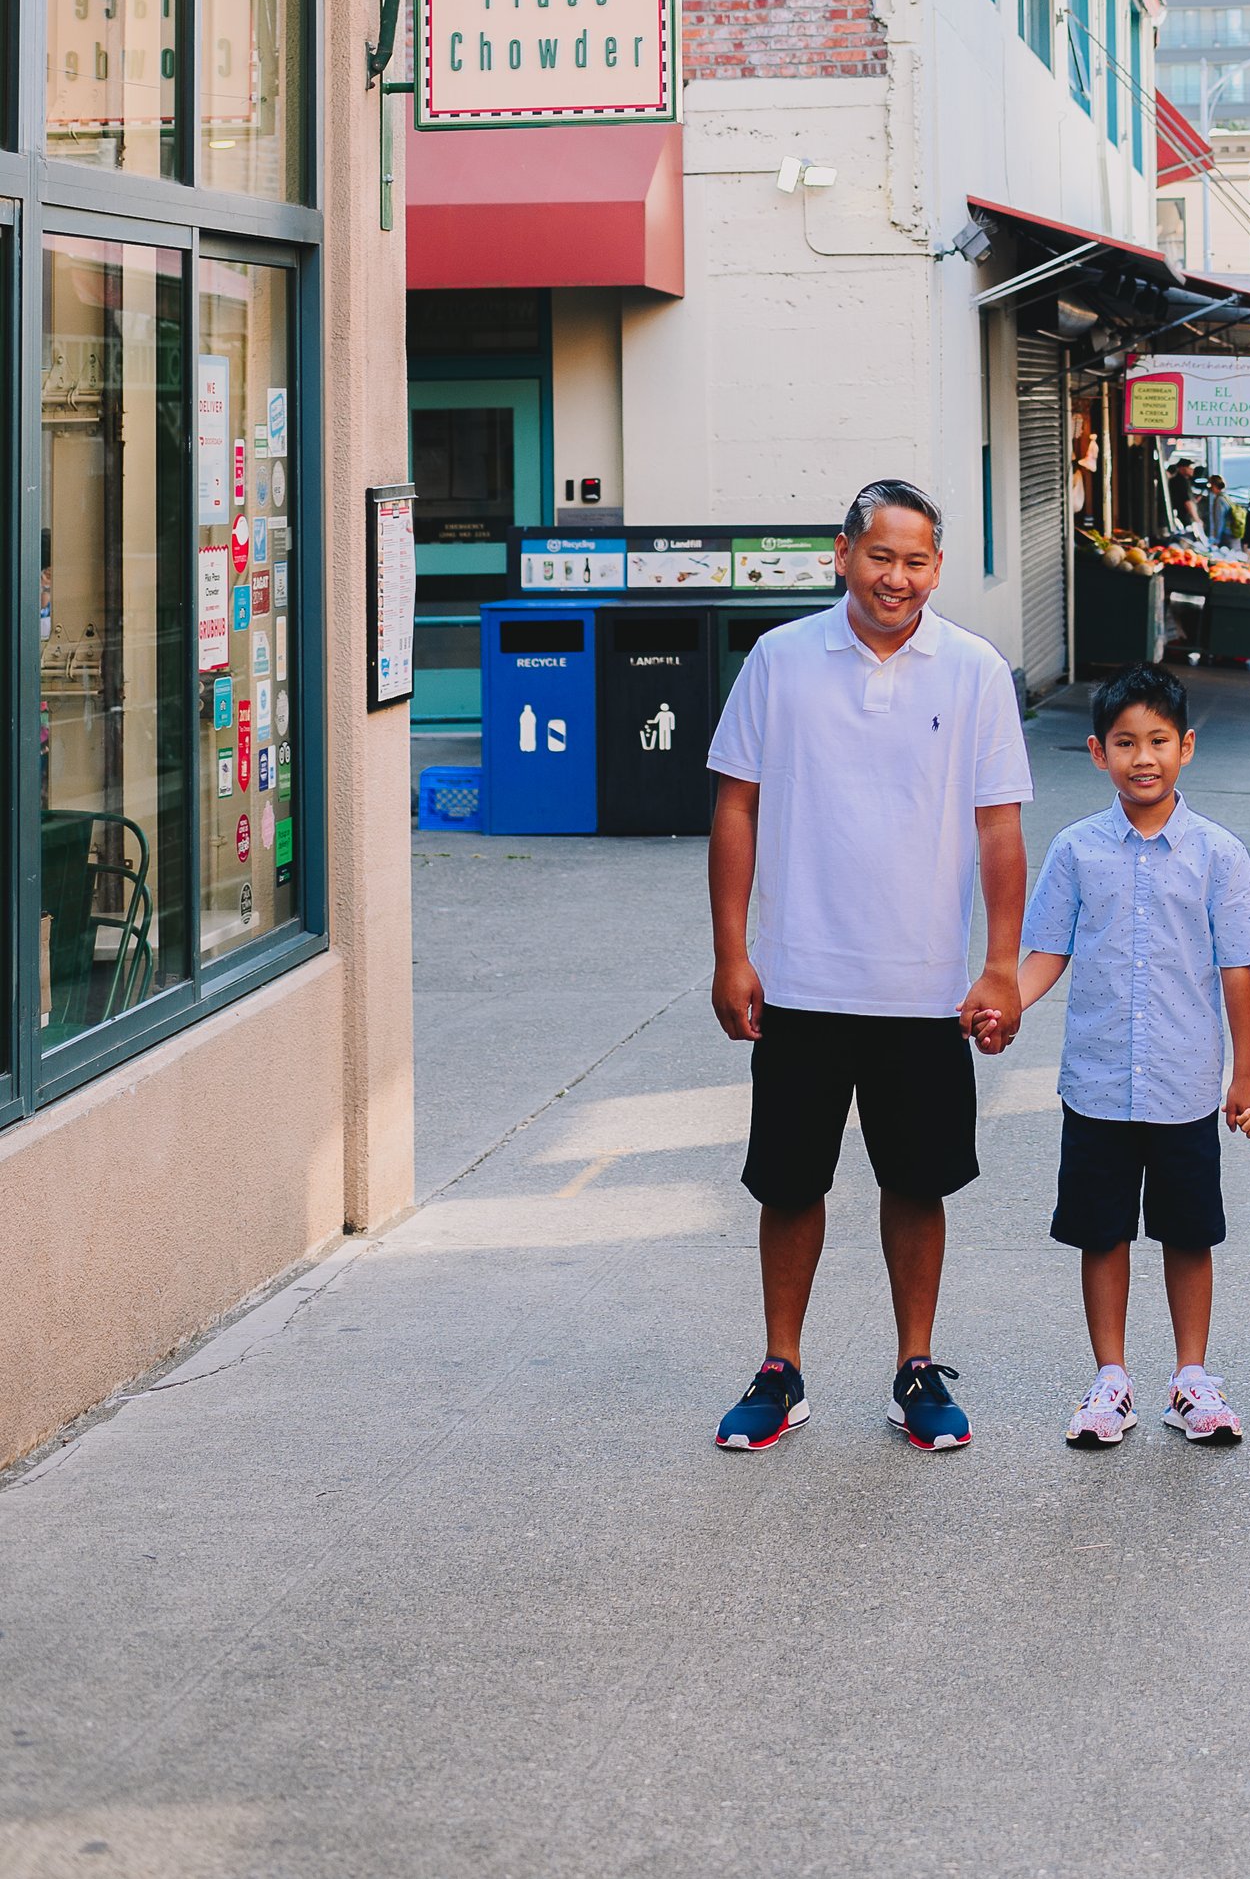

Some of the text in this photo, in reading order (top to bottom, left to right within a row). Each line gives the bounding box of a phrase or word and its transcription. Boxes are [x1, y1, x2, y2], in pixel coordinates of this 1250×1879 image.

[450, 29, 643, 71] Chowder
[206, 381, 216, 394] WE
[1214, 386, 1232, 398] EL
[199, 400, 223, 413] DELIVER
[1196, 415, 1250, 427] LATINO
[562, 539, 596, 550] Recycling
[670, 539, 702, 548] Landfill
[253, 575, 269, 591] ZAGAT
[199, 618, 226, 640] GRUBHUB
[516, 657, 567, 668] RECYCLE
[630, 656, 683, 666] LANDFILL
